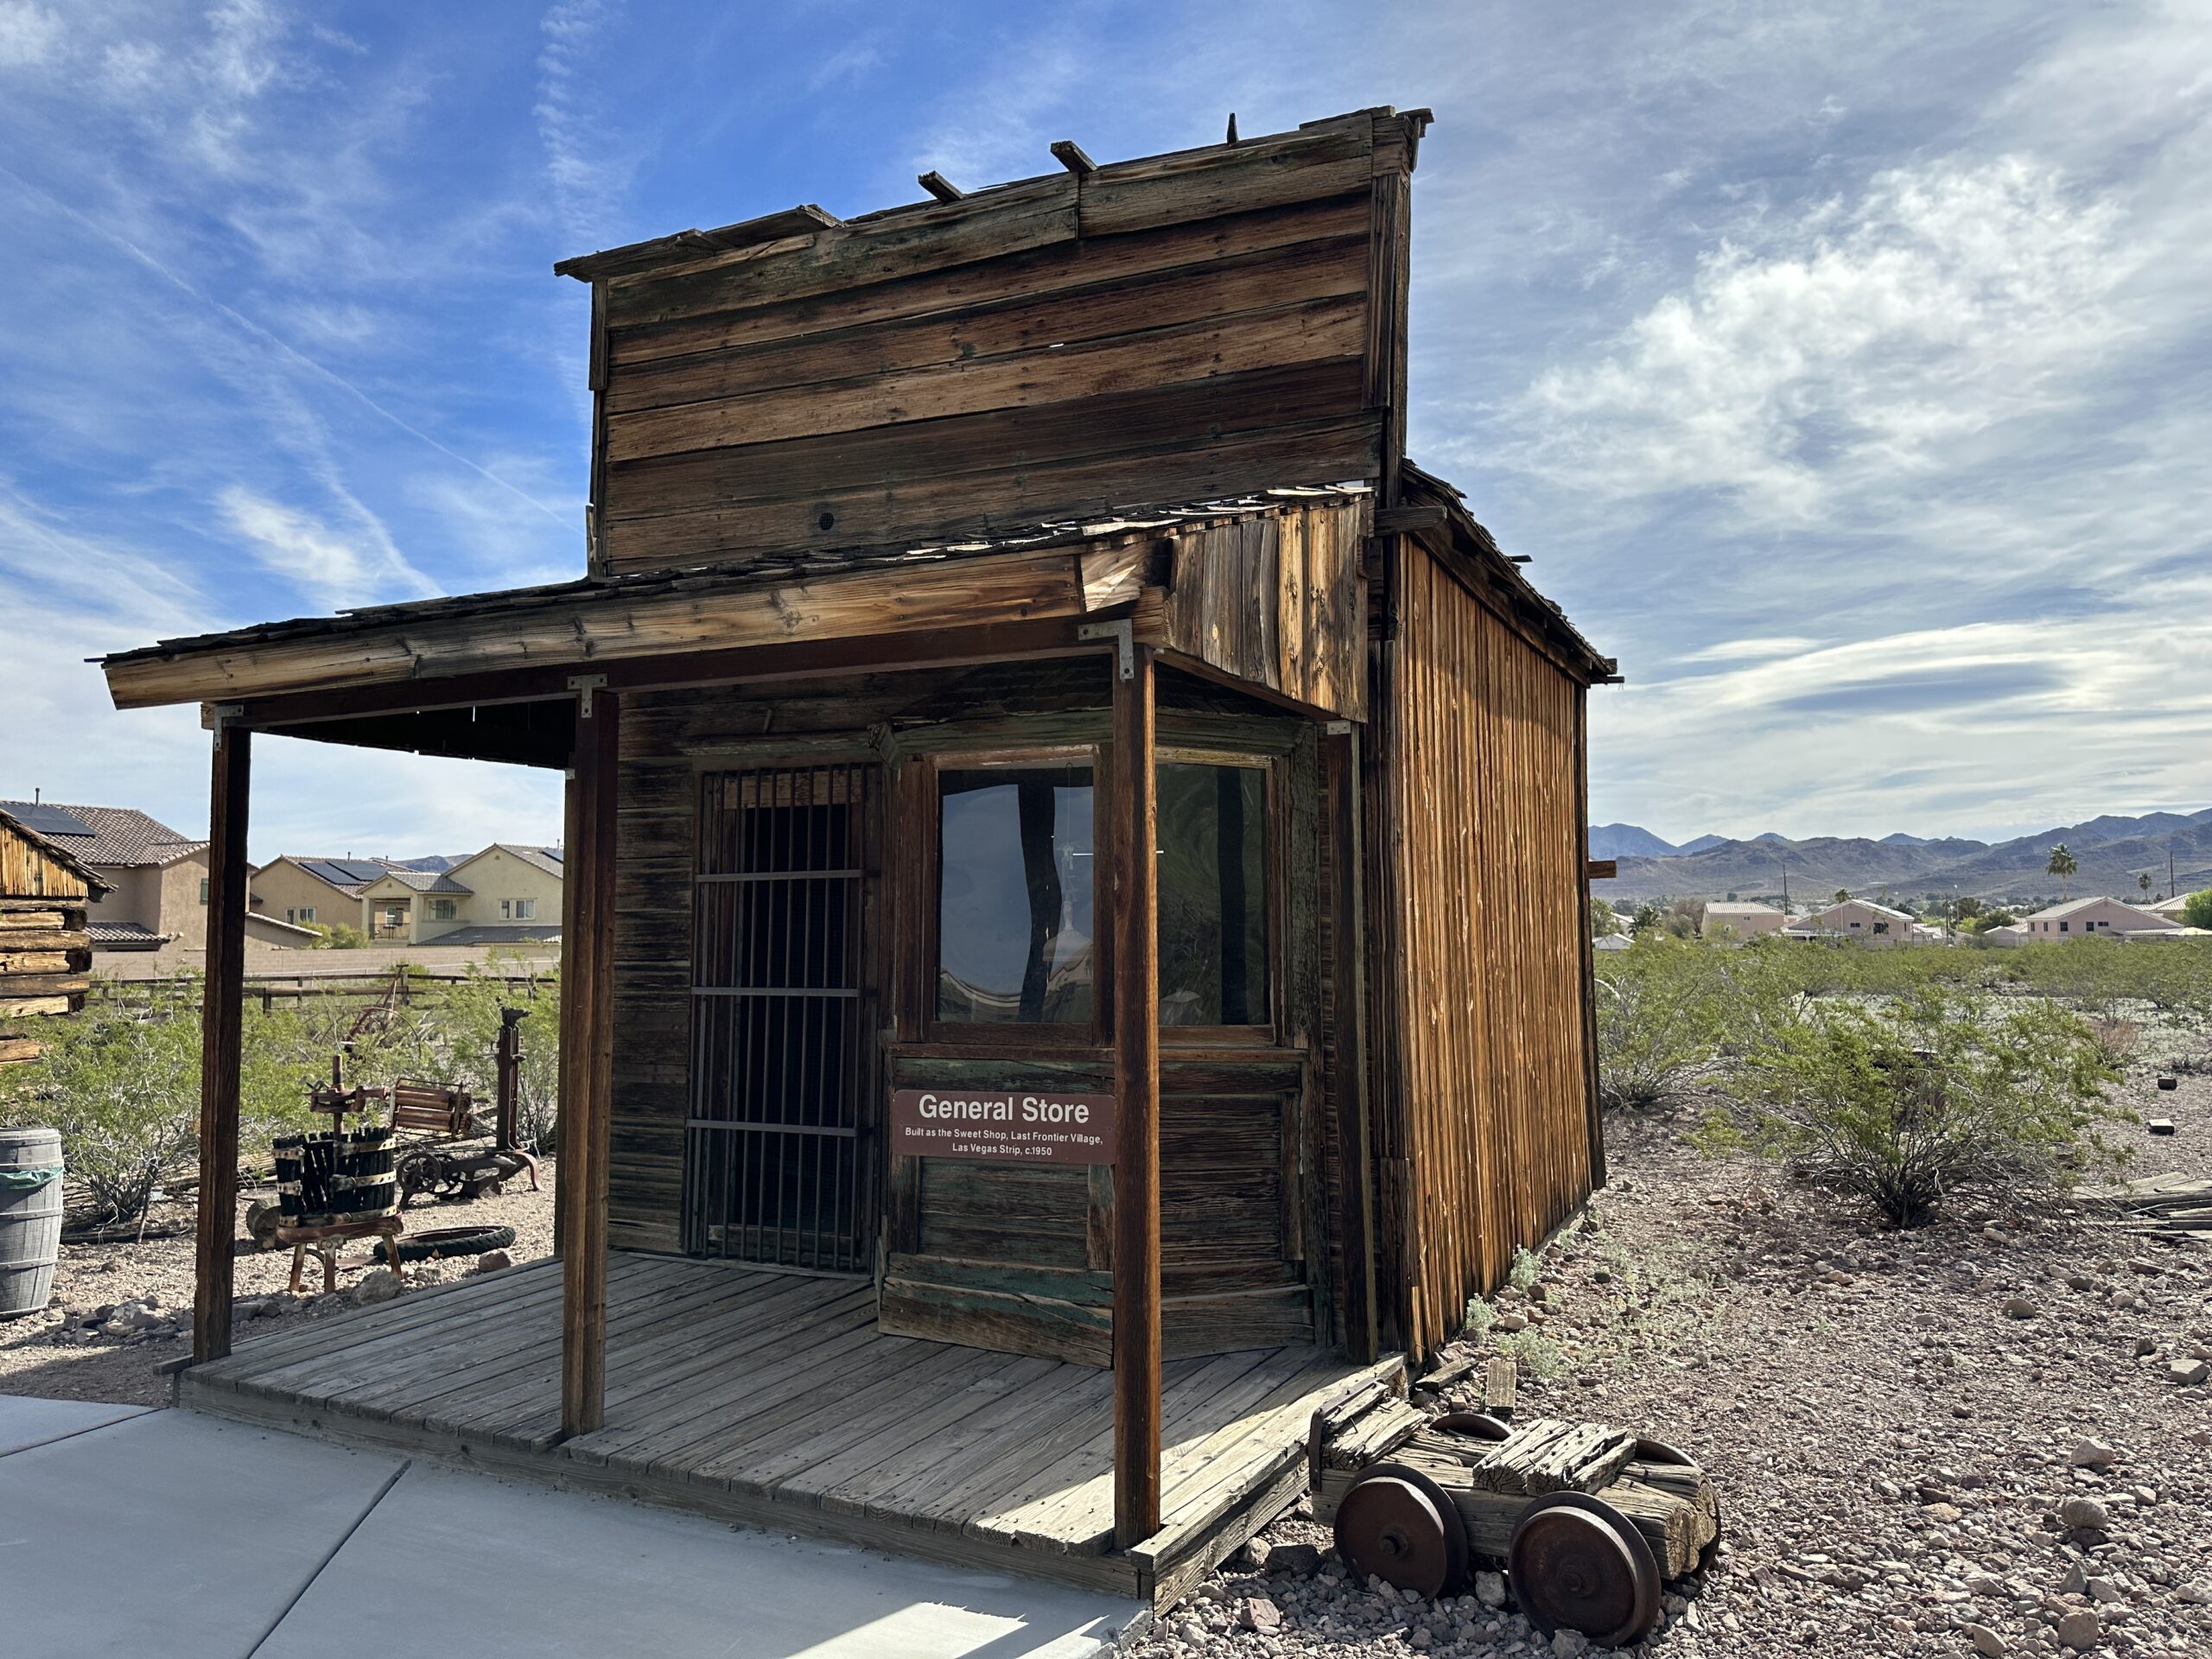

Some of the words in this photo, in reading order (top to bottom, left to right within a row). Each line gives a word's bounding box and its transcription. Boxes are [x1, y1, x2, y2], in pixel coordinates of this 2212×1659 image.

[919, 1095, 1013, 1120] General
[1022, 1097, 1089, 1123] Store
[955, 1129, 981, 1138] Sweet
[983, 1130, 1008, 1141] Shop,
[1012, 1131, 1030, 1140] Last
[1033, 1132, 1068, 1141] Frontier
[1071, 1134, 1103, 1145] Village,
[970, 1144, 997, 1154] Vegas
[1000, 1145, 1022, 1155] Strip,
[1026, 1147, 1052, 1155] c.1950
